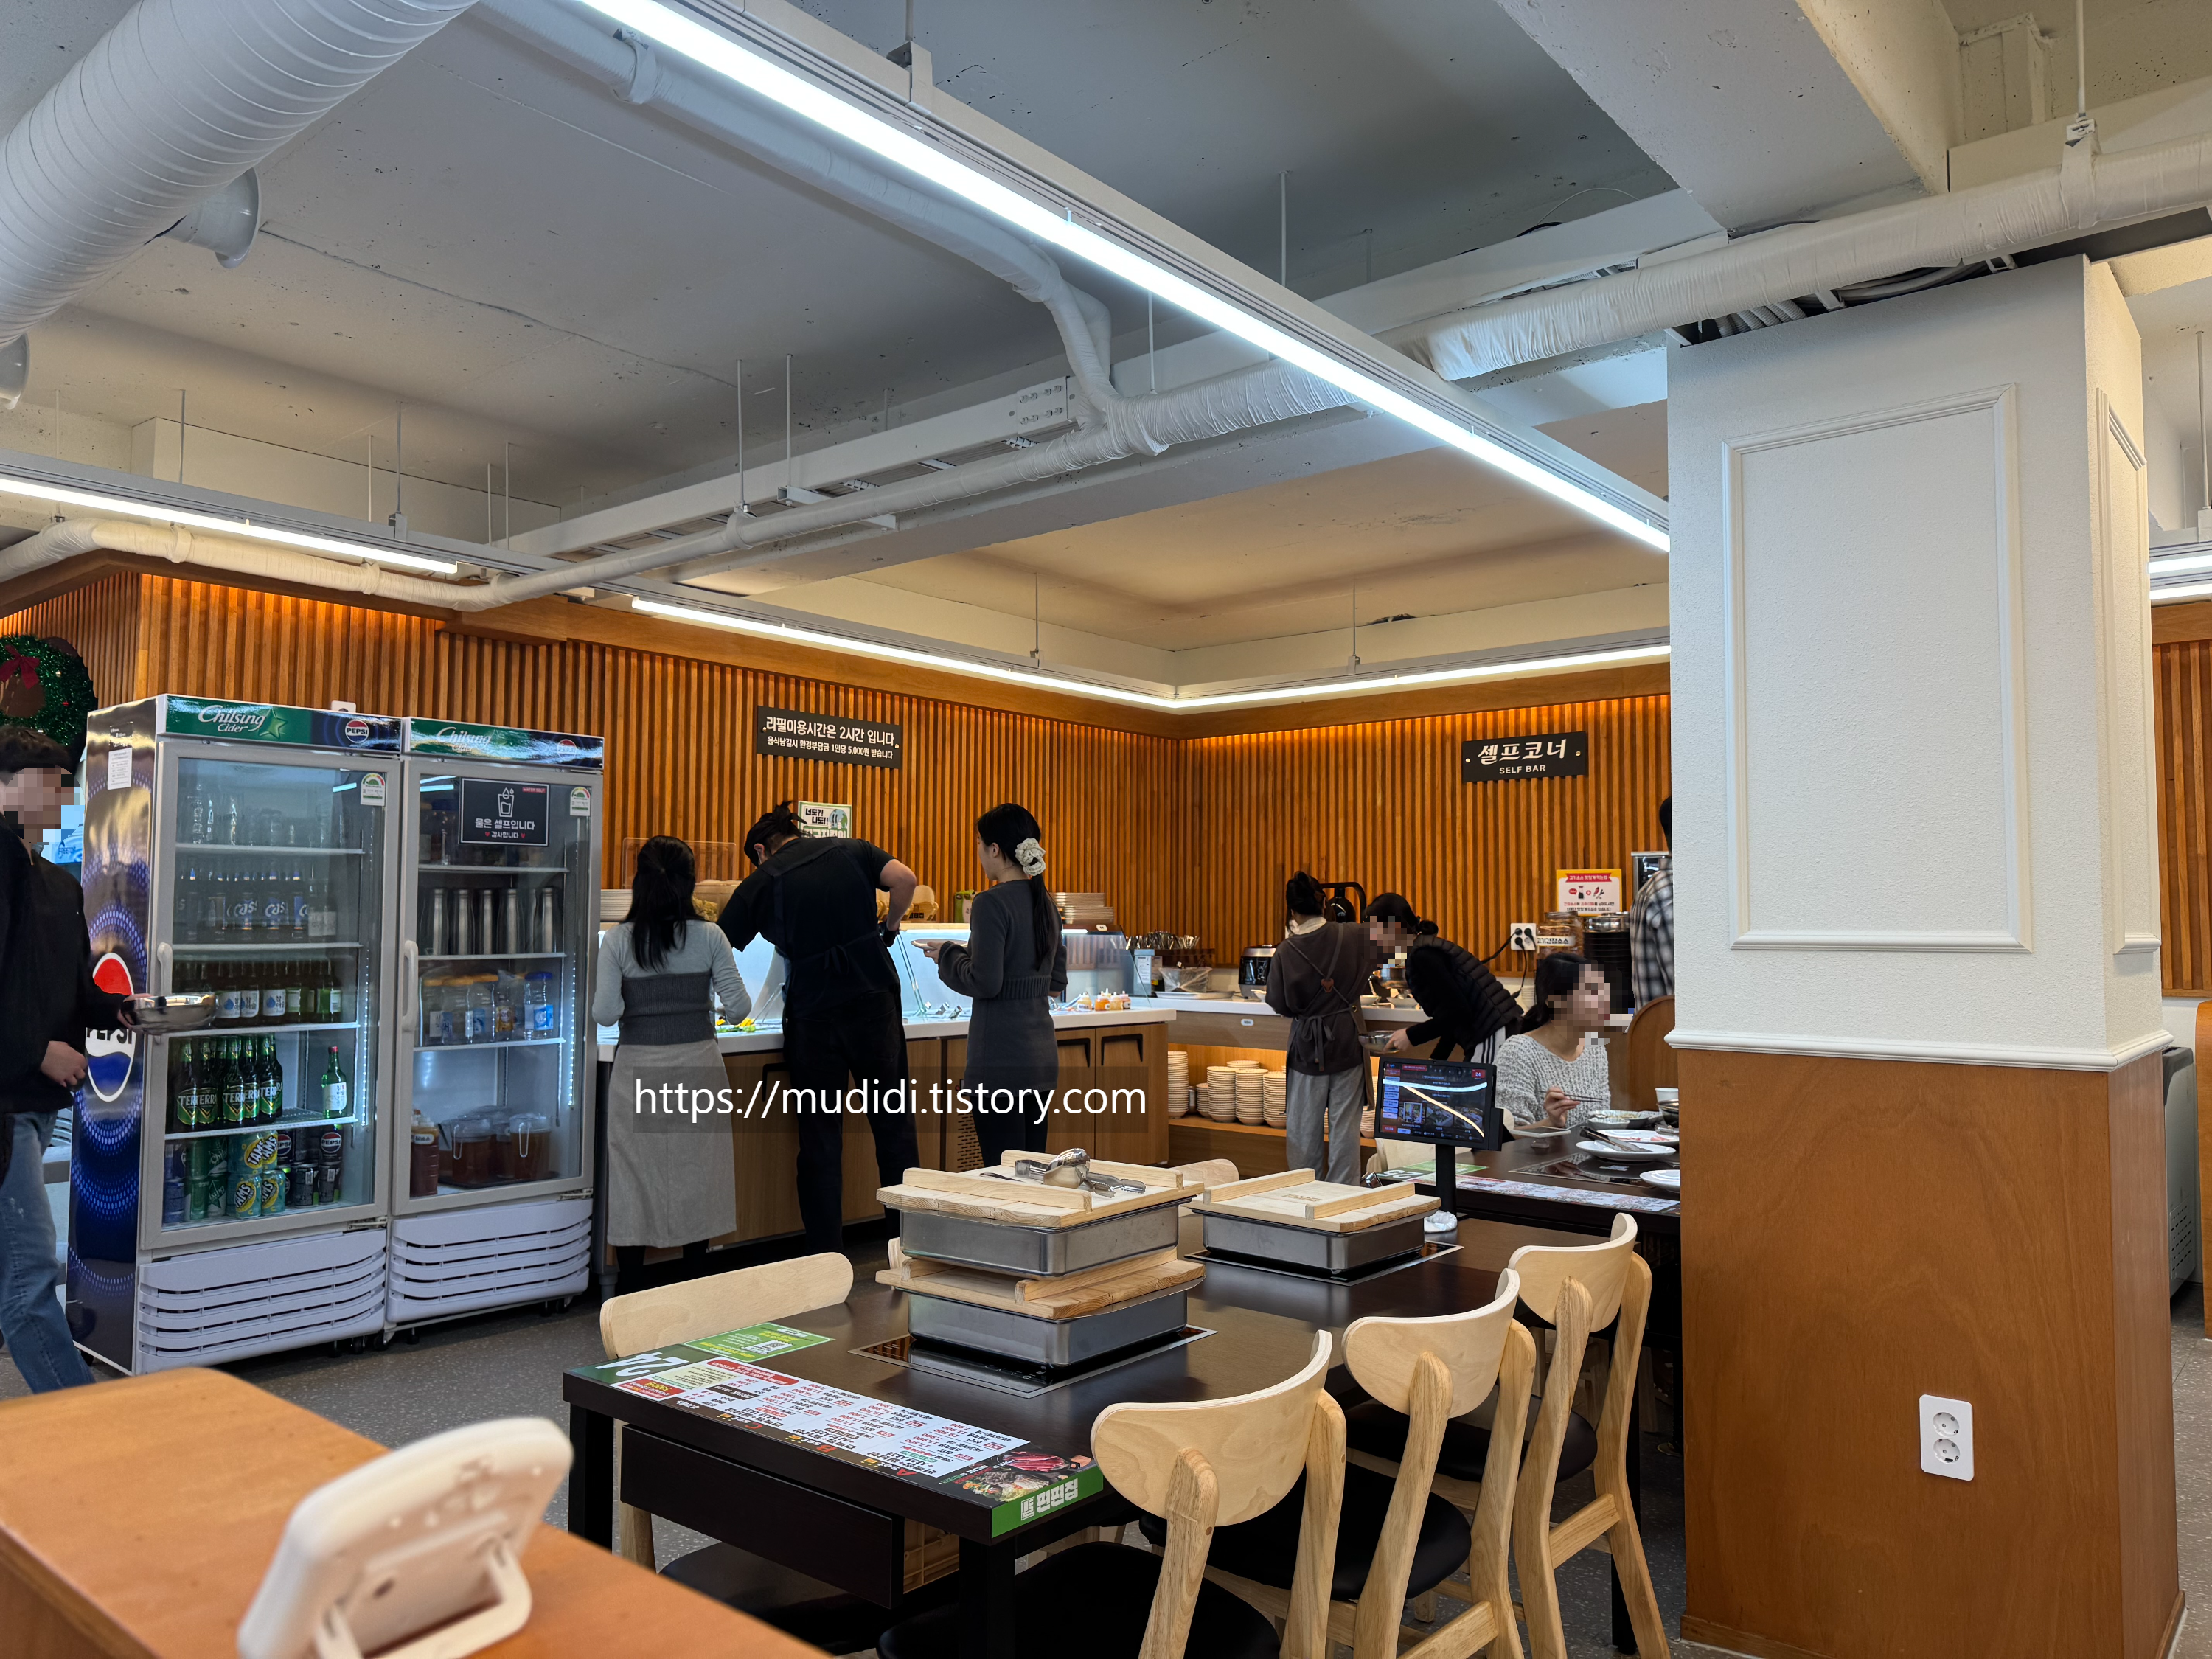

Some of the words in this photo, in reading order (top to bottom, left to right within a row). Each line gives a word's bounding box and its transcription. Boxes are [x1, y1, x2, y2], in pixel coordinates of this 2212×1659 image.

[198, 704, 266, 731] Chilsung
[217, 723, 248, 733] Cider
[766, 717, 837, 738] 리필이용시간은
[840, 726, 865, 742] 2시간
[867, 729, 894, 746] 입니다
[767, 736, 798, 748] 음식남길시
[799, 740, 830, 752] 환경부담금
[832, 744, 846, 754] 1인당
[848, 746, 870, 757] 5,000원
[871, 748, 893, 759] 받습니다
[1478, 739, 1567, 765] 셀프코너
[1499, 766, 1523, 774] SELF
[1526, 765, 1546, 773] BAR
[476, 818, 492, 829] 물은
[494, 819, 535, 830] 셀프입니다
[595, 1352, 689, 1377] 24
[877, 1461, 900, 1470] set
[897, 1468, 917, 1476] A
